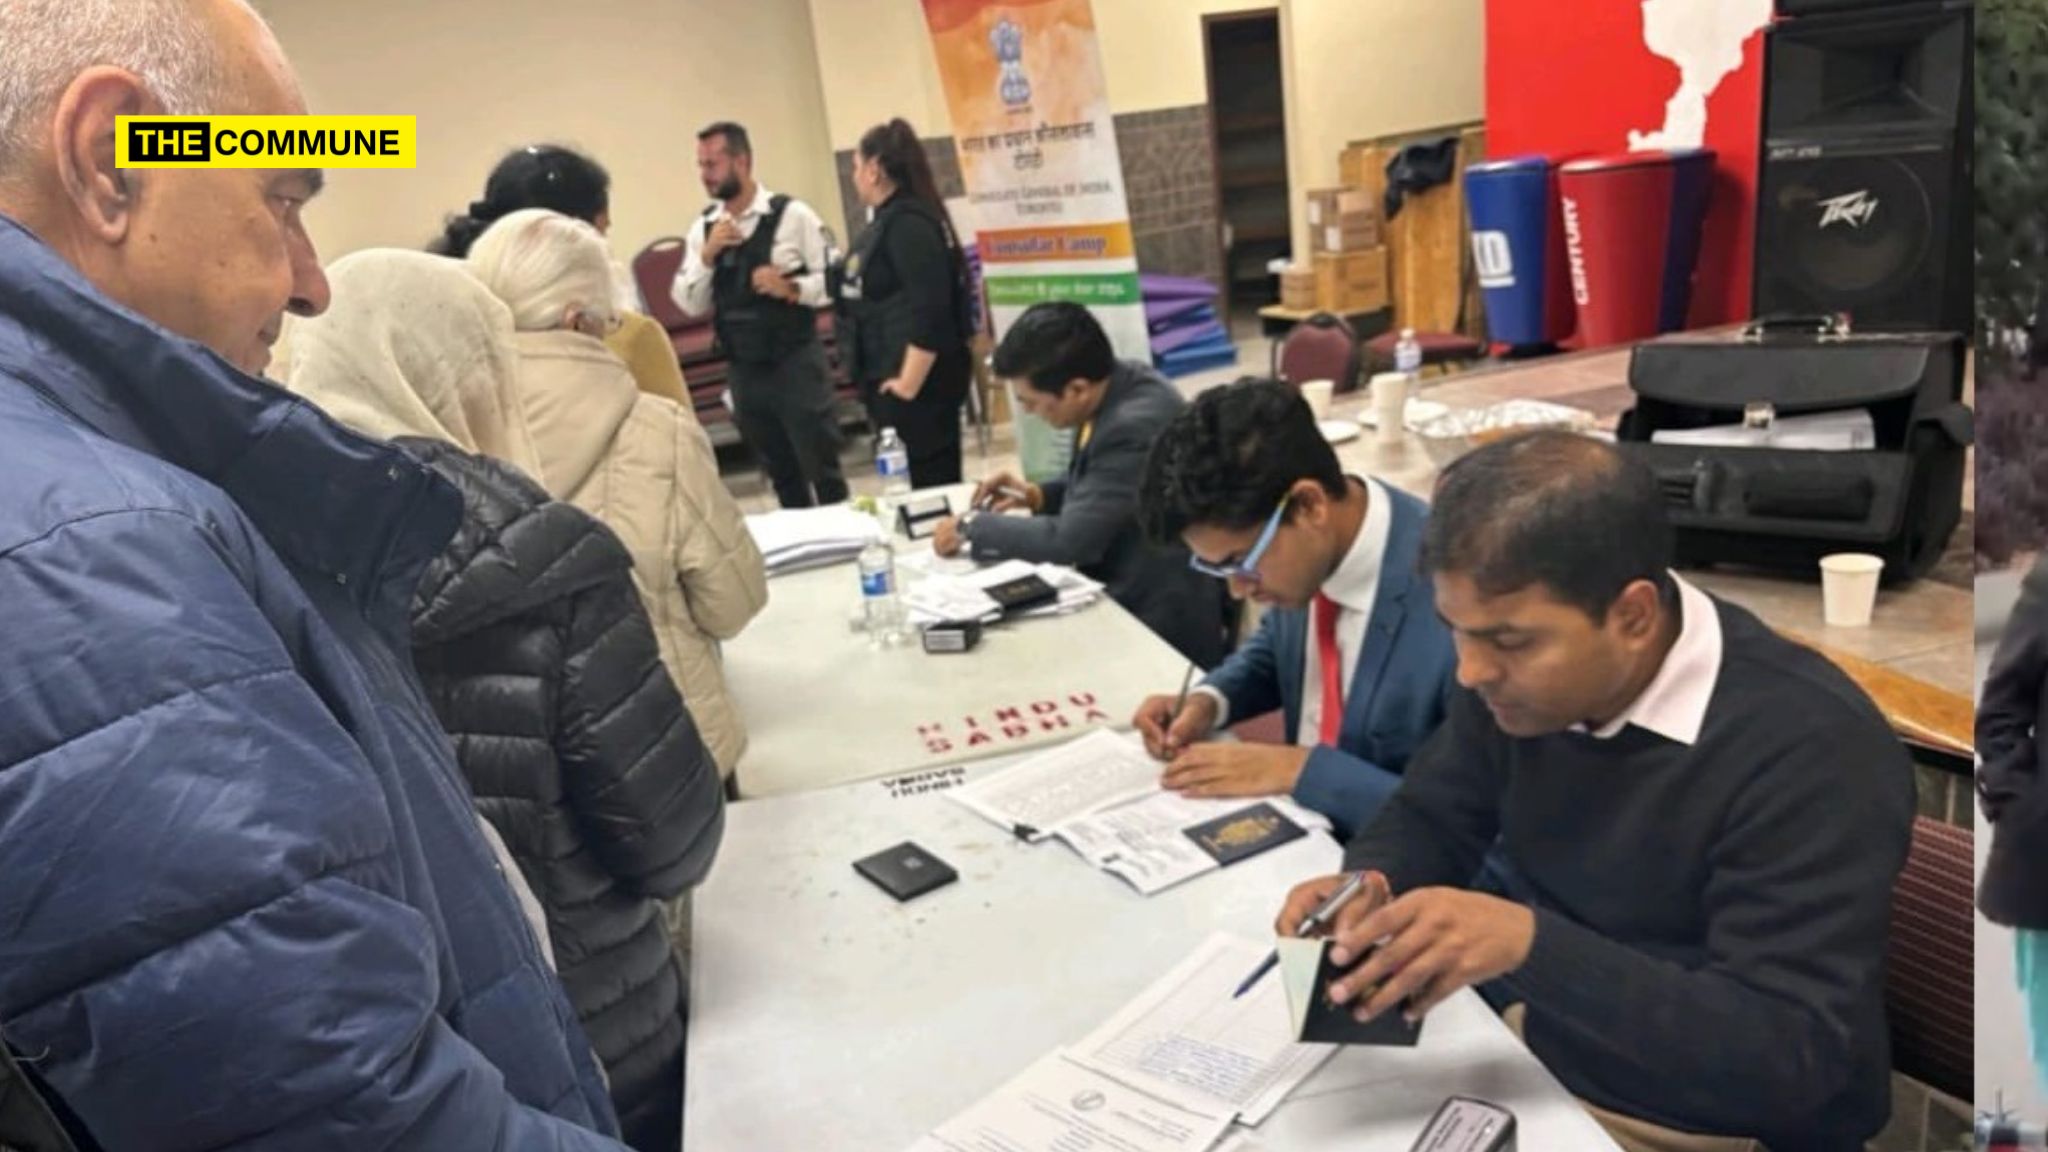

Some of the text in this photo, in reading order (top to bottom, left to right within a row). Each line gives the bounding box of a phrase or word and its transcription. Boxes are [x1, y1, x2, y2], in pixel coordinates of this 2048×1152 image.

[1562, 197, 1589, 305] CENTURY
[917, 692, 1096, 736] HINDU
[926, 709, 1108, 753] SABHA
